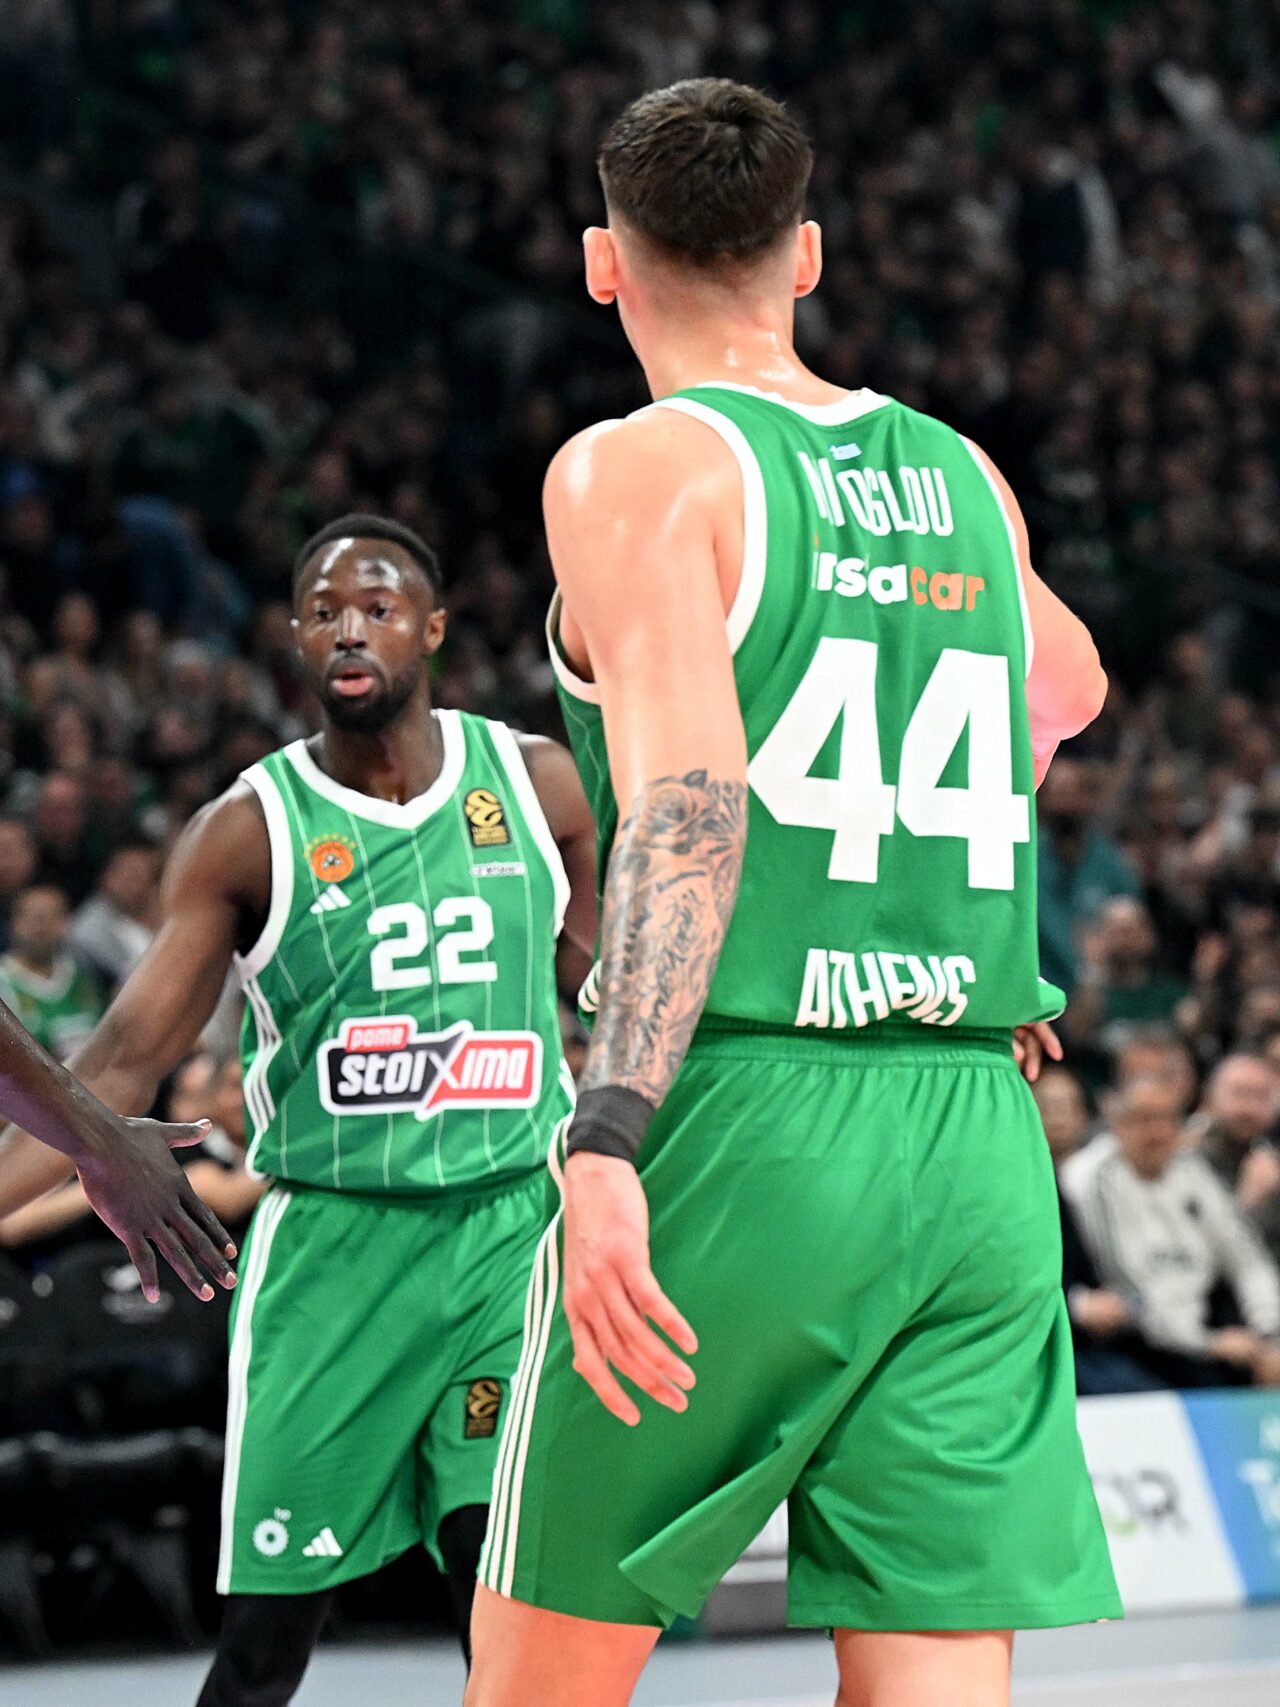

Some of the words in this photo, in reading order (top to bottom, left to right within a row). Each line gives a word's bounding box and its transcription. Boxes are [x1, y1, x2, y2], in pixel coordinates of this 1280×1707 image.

[746, 636, 1030, 891] 44
[367, 896, 498, 991] 22
[794, 948, 976, 1029] ATHENS
